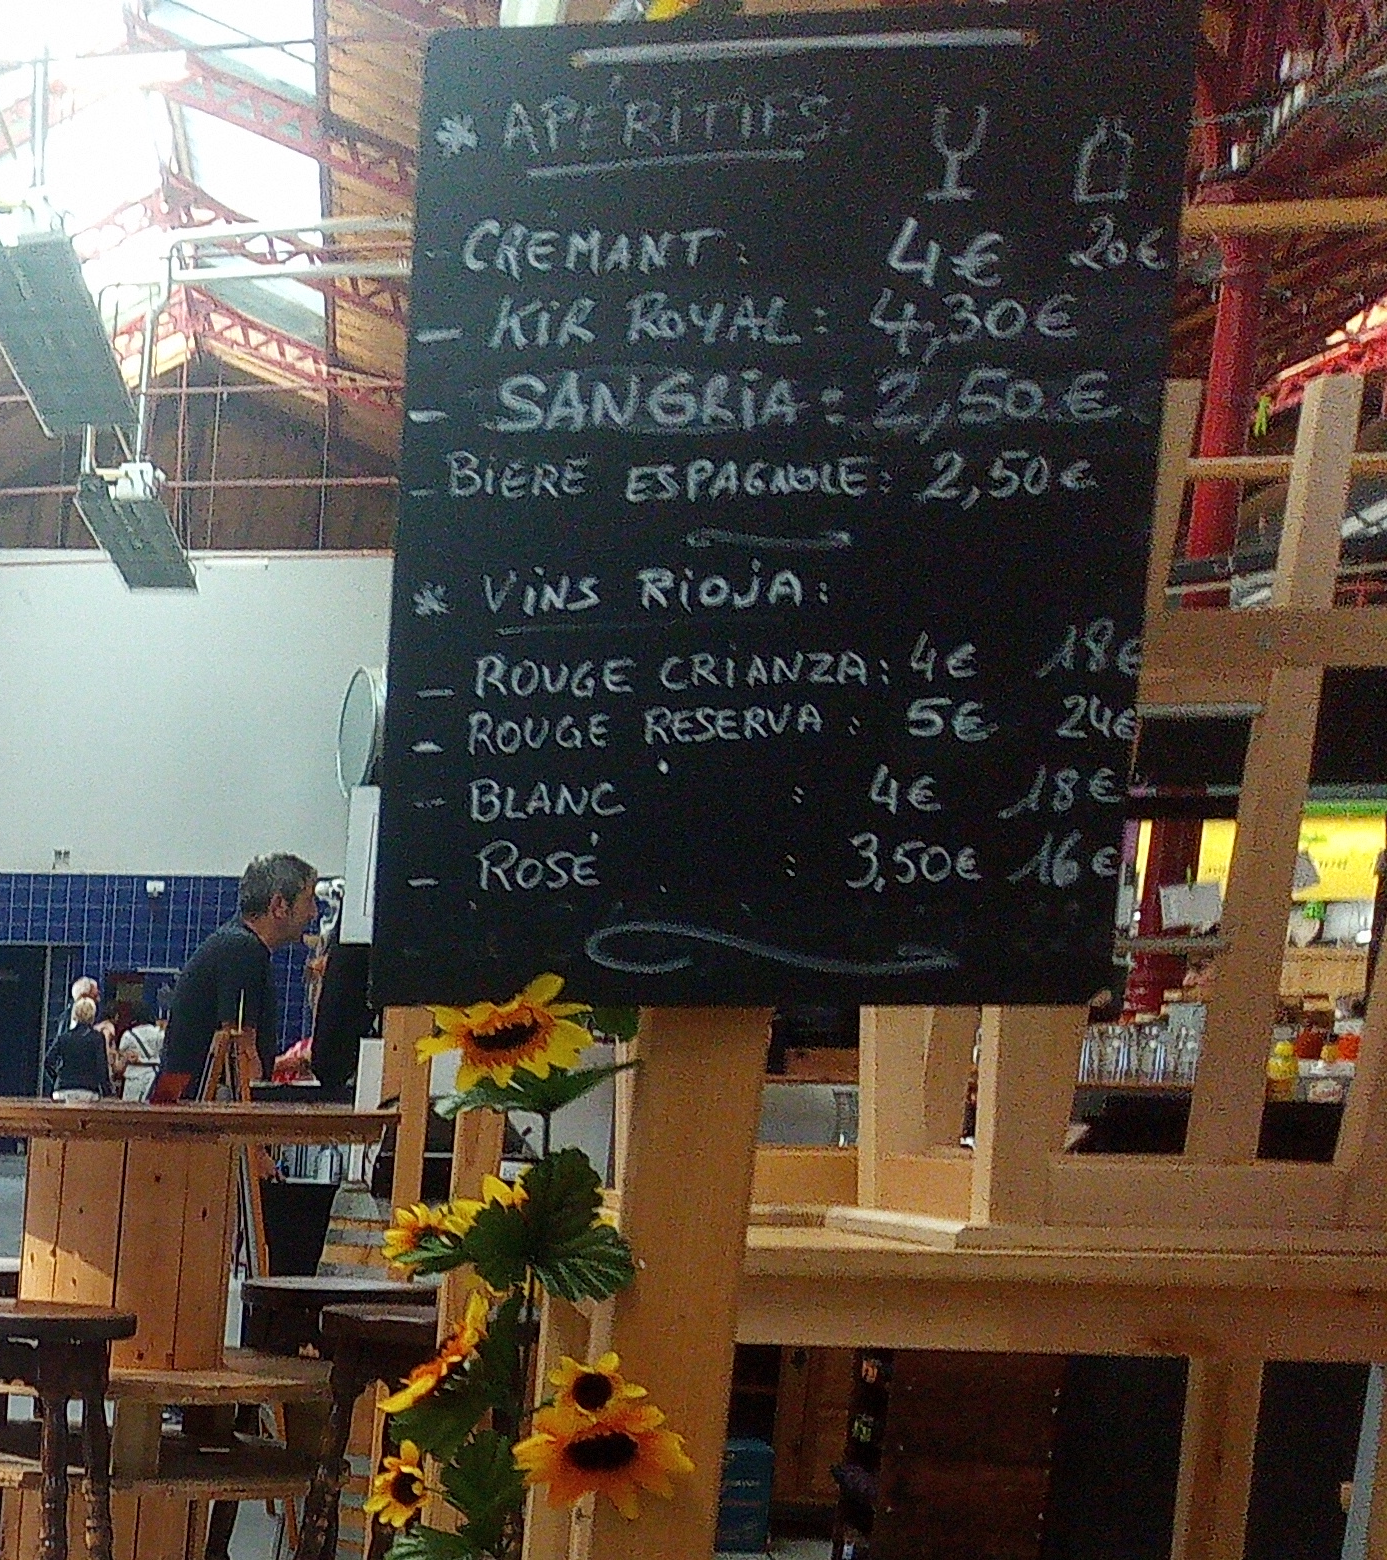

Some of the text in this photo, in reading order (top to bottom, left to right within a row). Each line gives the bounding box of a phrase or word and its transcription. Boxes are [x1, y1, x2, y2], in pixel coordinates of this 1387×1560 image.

[473, 652, 634, 700] ROUGE
[467, 709, 611, 757] ROUGE
[468, 776, 626, 824] BLANC
